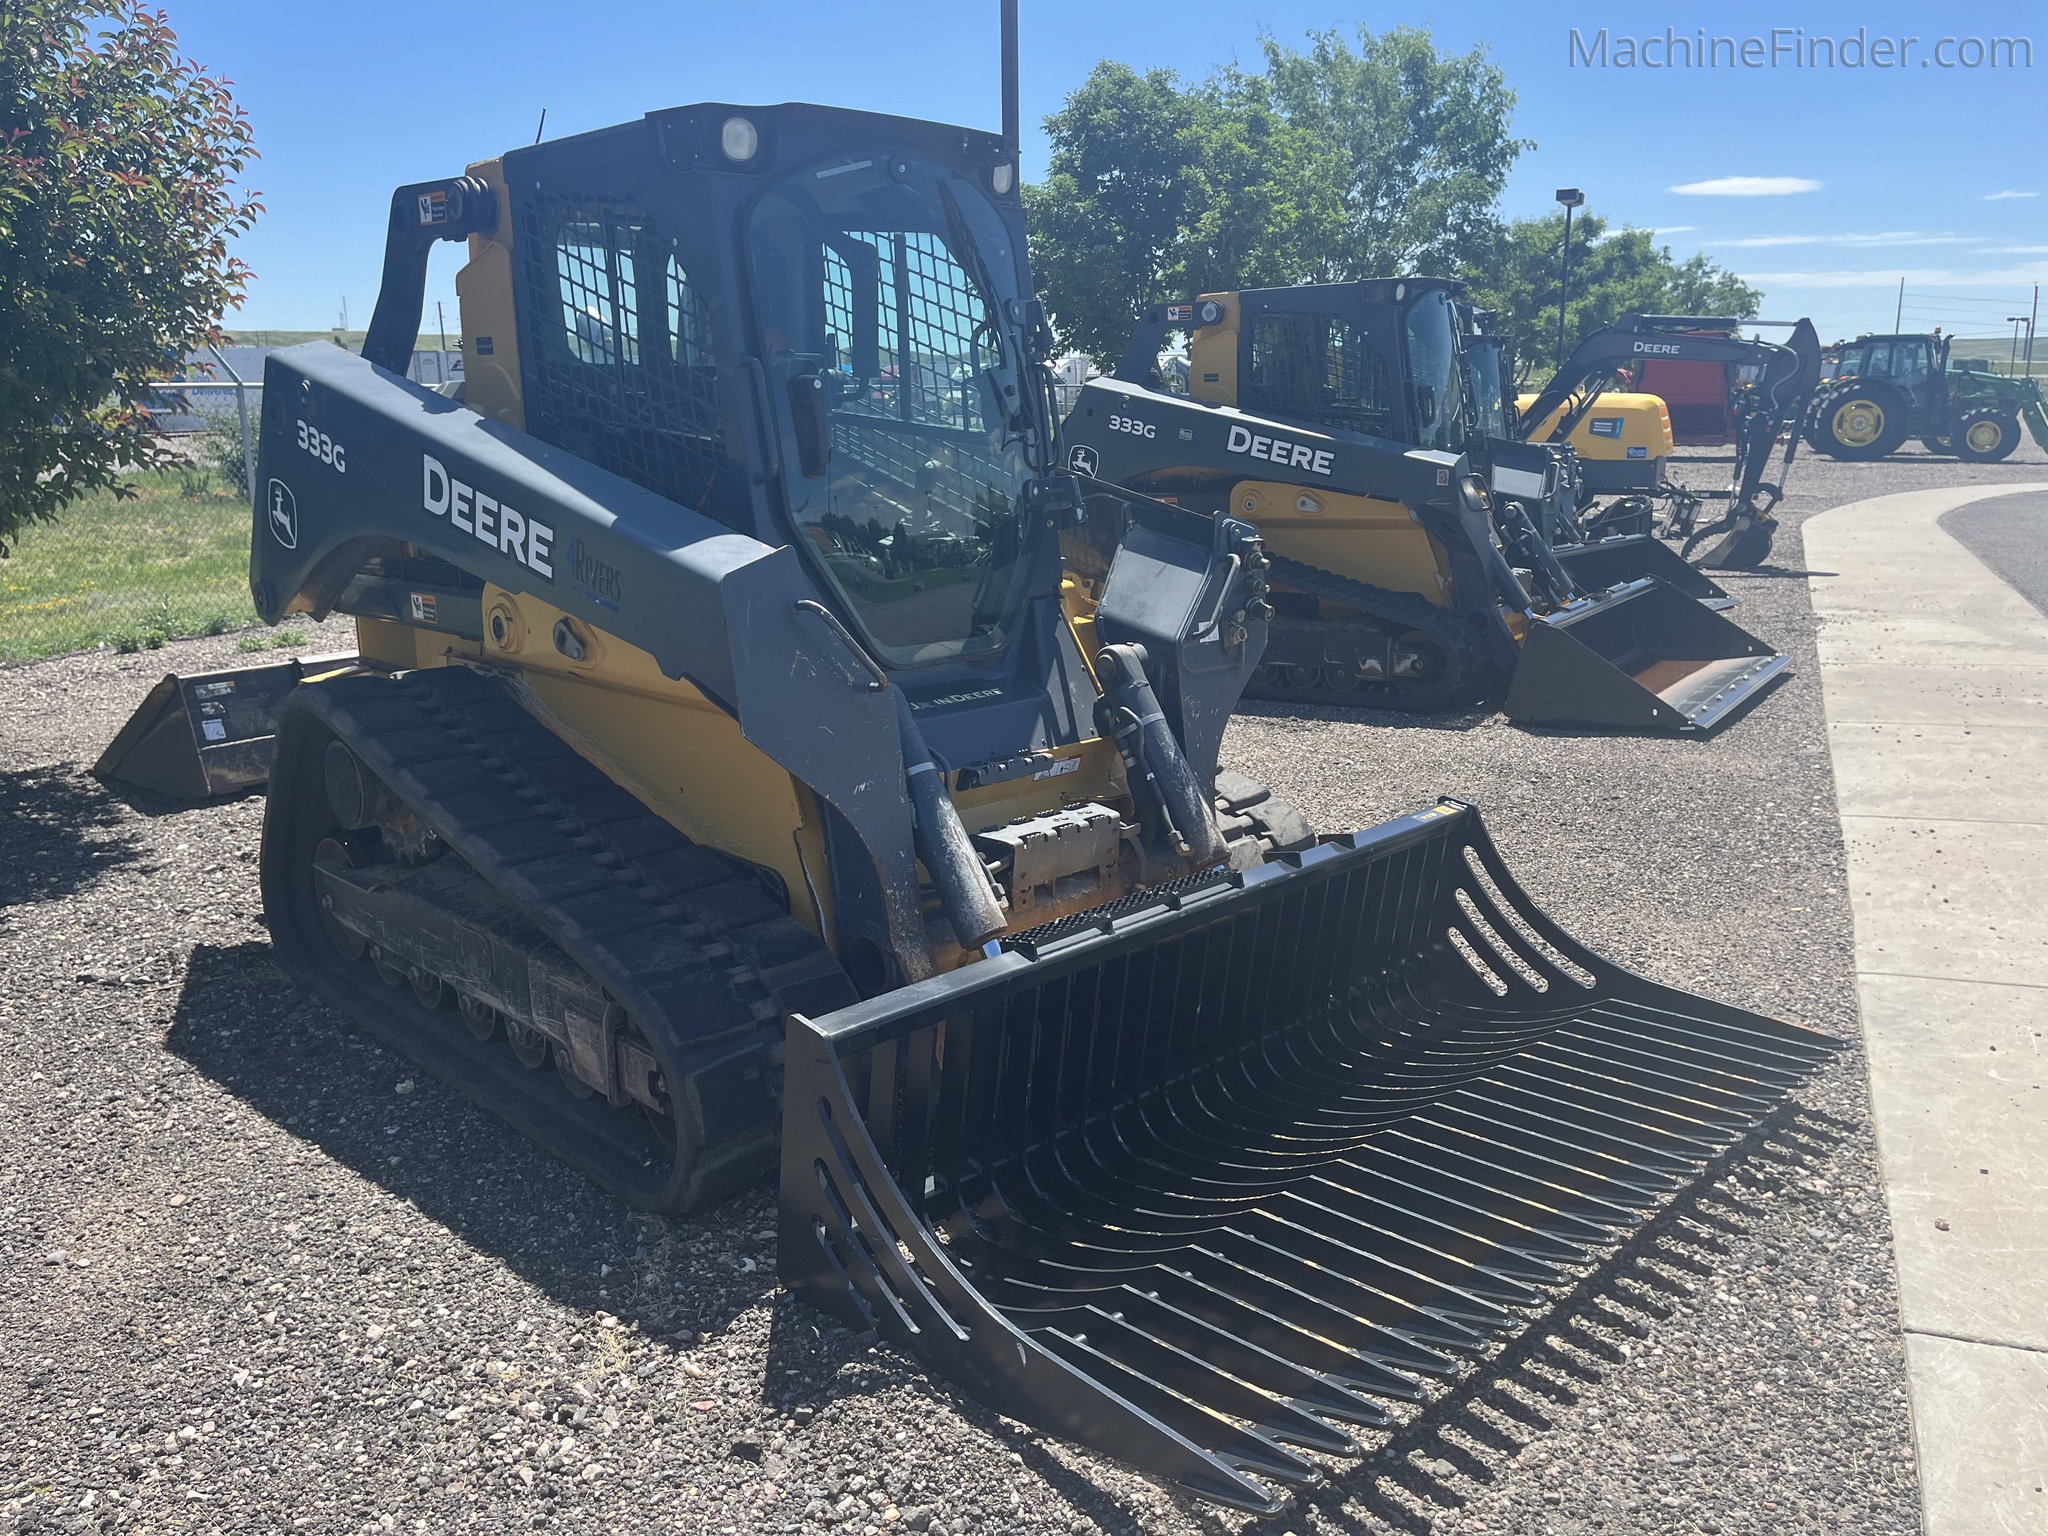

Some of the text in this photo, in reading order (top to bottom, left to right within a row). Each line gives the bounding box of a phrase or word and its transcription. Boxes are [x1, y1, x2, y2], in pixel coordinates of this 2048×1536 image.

[1633, 341, 1680, 354] DEERE
[1108, 414, 1156, 439] 333G
[296, 419, 346, 473] 333G
[1226, 424, 1335, 475] DEERE
[423, 453, 554, 579] DEERE
[949, 687, 1003, 702] DEERE
